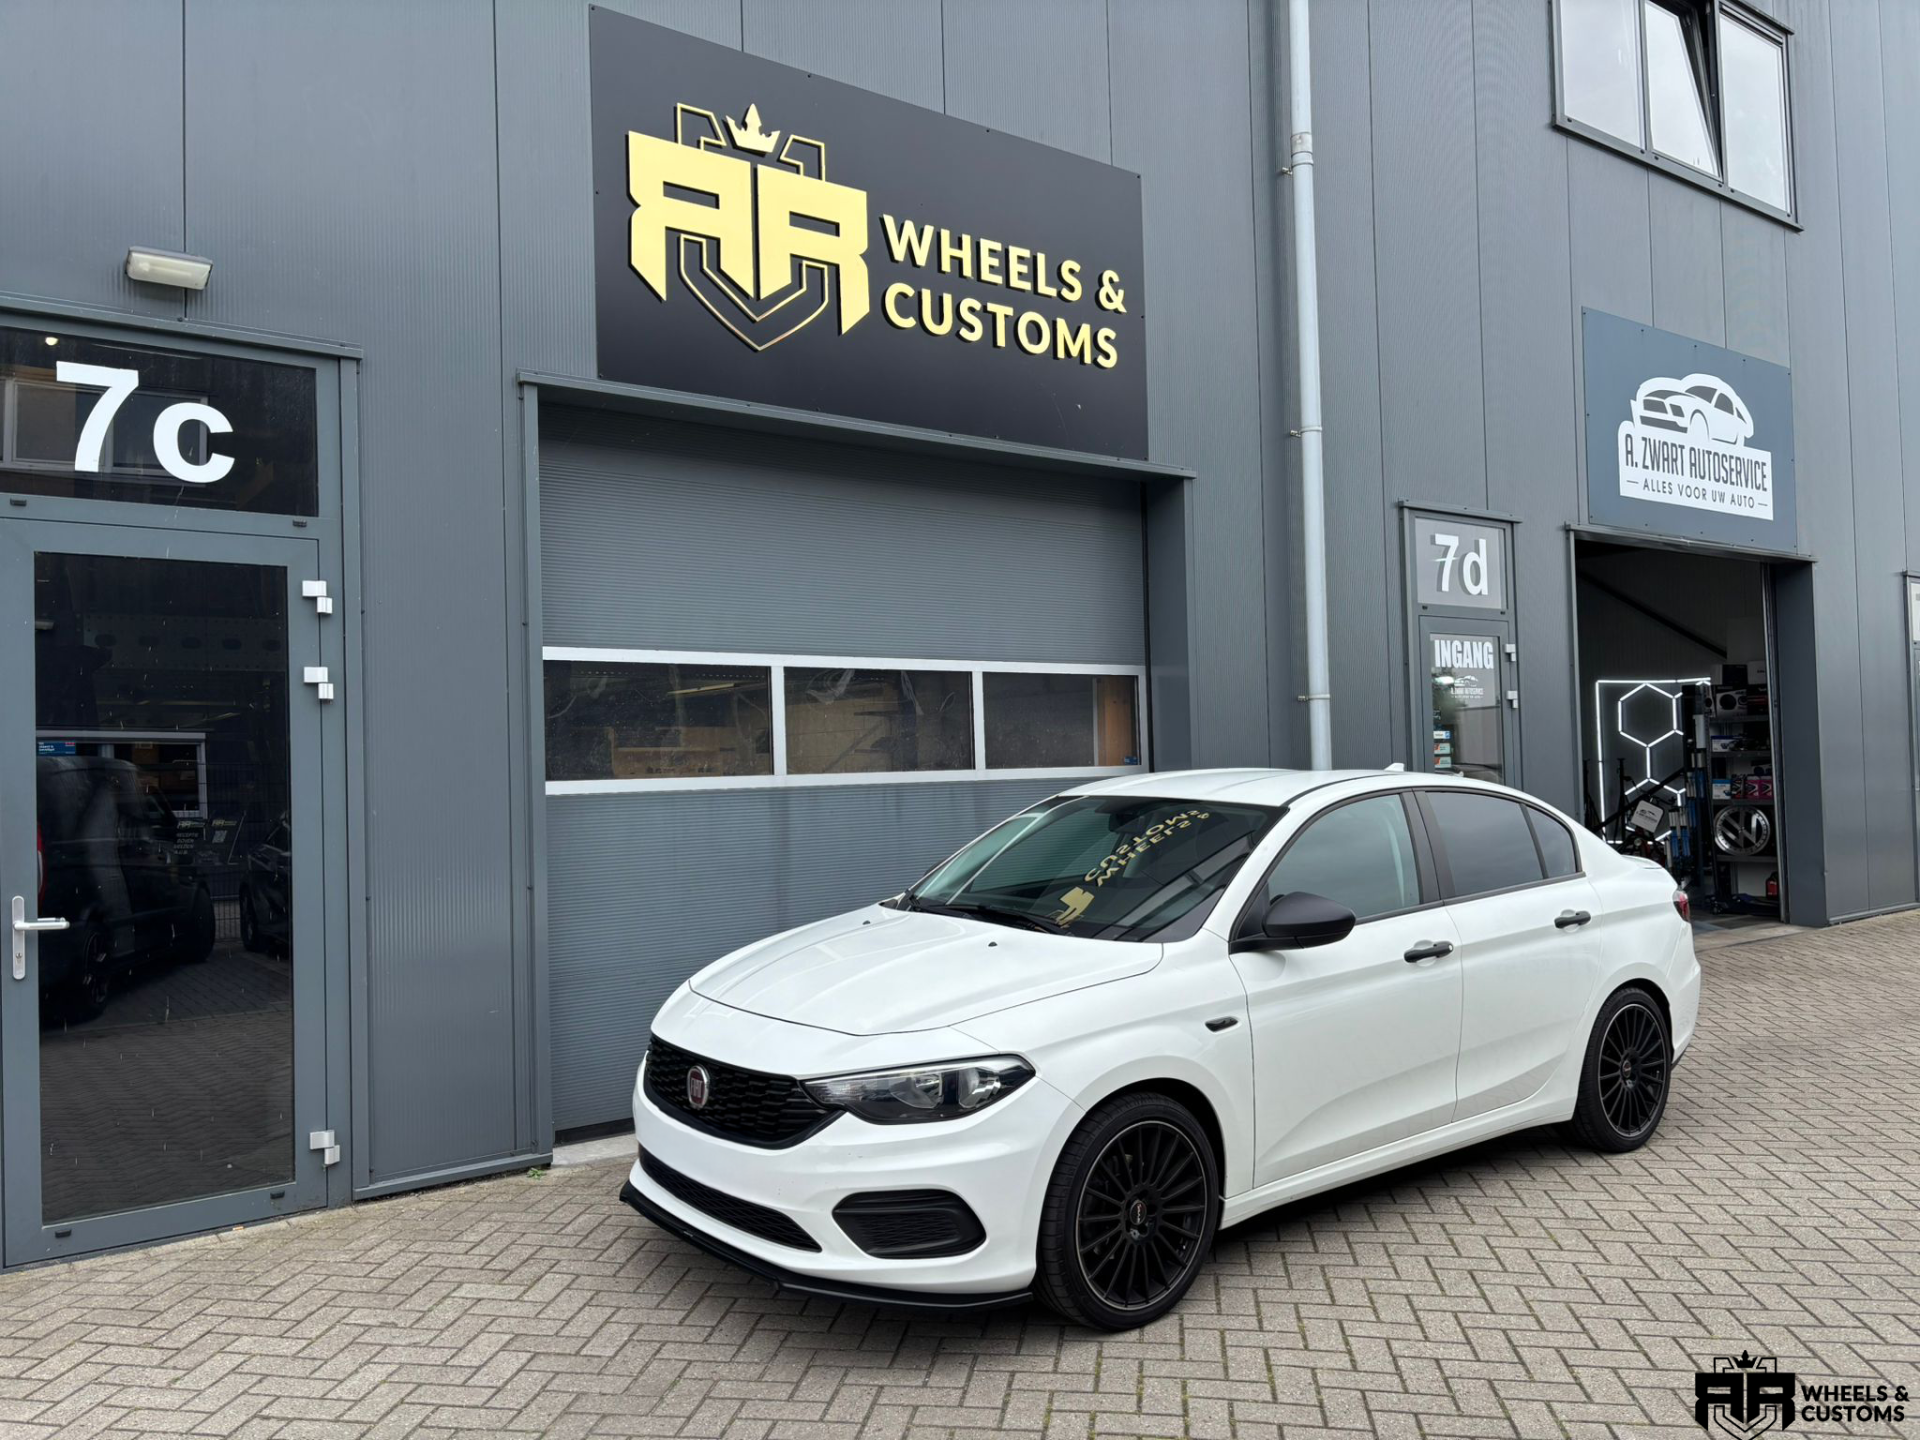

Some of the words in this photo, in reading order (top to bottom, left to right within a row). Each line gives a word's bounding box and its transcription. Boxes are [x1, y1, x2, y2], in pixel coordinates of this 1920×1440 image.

[882, 214, 1083, 302] WHEELS
[1098, 269, 1128, 313] &
[884, 282, 1119, 369] CUSTOMS
[1625, 433, 1639, 468] A.
[1641, 436, 1685, 477] ZWART
[1689, 446, 1768, 492] AUTOSERVICE
[1643, 478, 1673, 495] ALLES
[1677, 483, 1707, 501] VOOR
[1711, 489, 1726, 504] UW
[1730, 494, 1755, 509] AUTO
[1434, 533, 1489, 596] 7d
[1434, 639, 1494, 669] INGANG
